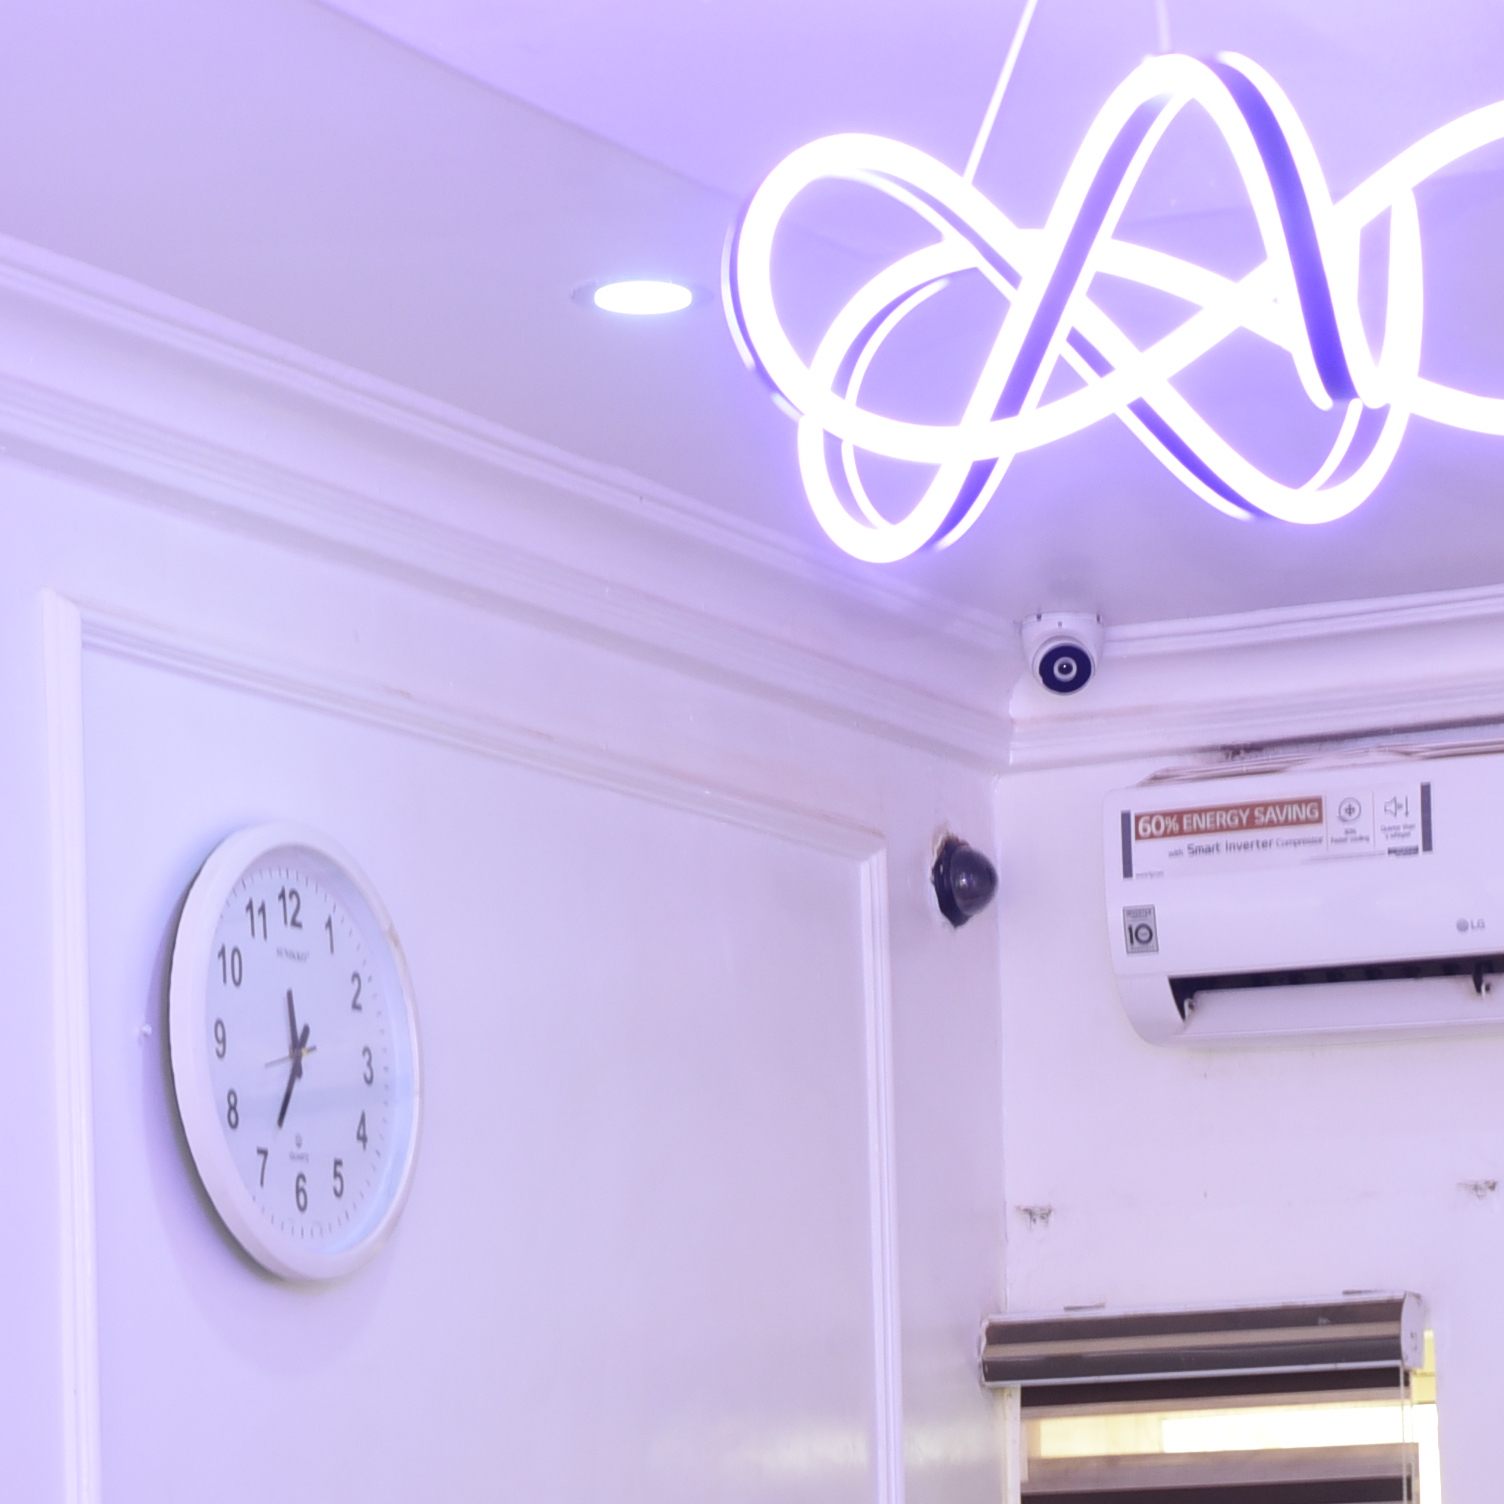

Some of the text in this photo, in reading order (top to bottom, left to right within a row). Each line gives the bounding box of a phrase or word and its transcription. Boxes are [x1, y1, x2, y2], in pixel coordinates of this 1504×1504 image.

[1138, 801, 1320, 838] 60% ENERGY SAVING
[1187, 842, 1221, 857] Smart
[1225, 838, 1273, 852] Inverter
[245, 898, 268, 940] 11
[277, 886, 303, 929] 12
[1470, 918, 1486, 930] LG
[325, 916, 334, 954] 1
[217, 944, 243, 987] 10
[351, 972, 362, 1011] 2
[214, 1019, 227, 1059] 9
[362, 1047, 374, 1086] 3
[226, 1089, 240, 1130] 8
[356, 1111, 368, 1150] 4
[256, 1147, 269, 1187] 7
[333, 1158, 344, 1199] 5
[295, 1172, 308, 1213] 6
